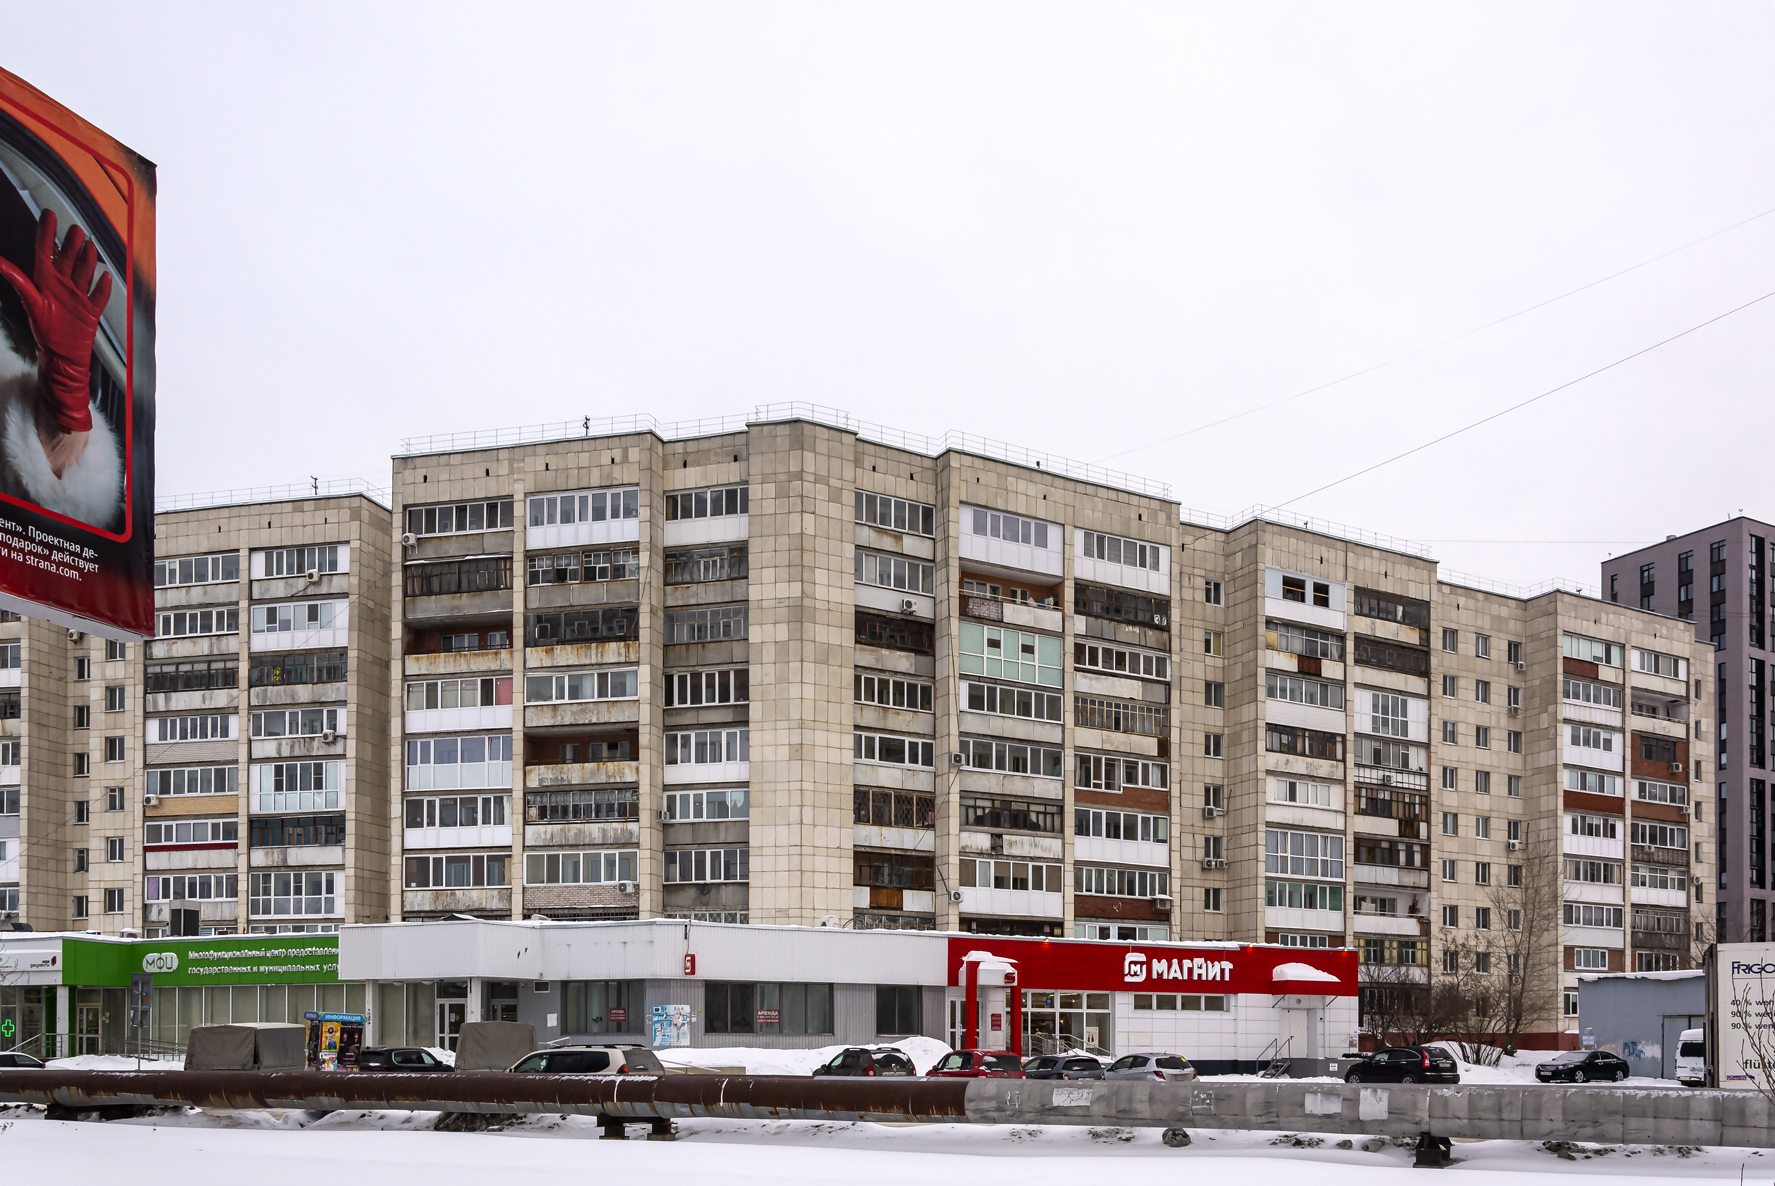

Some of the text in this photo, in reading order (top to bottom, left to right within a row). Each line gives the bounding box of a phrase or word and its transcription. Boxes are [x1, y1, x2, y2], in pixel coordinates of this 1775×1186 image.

[0, 532, 99, 573] подарок» действует
[28, 525, 81, 554] Проектная
[82, 547, 98, 559] де-
[0, 546, 82, 581] и на strana.com.
[188, 948, 265, 960] Многофункциональный
[266, 949, 287, 958] центр
[188, 965, 252, 975] государственных
[252, 965, 258, 973] и
[259, 964, 321, 974] муниципальных
[1151, 957, 1234, 981] МАГНИТ
